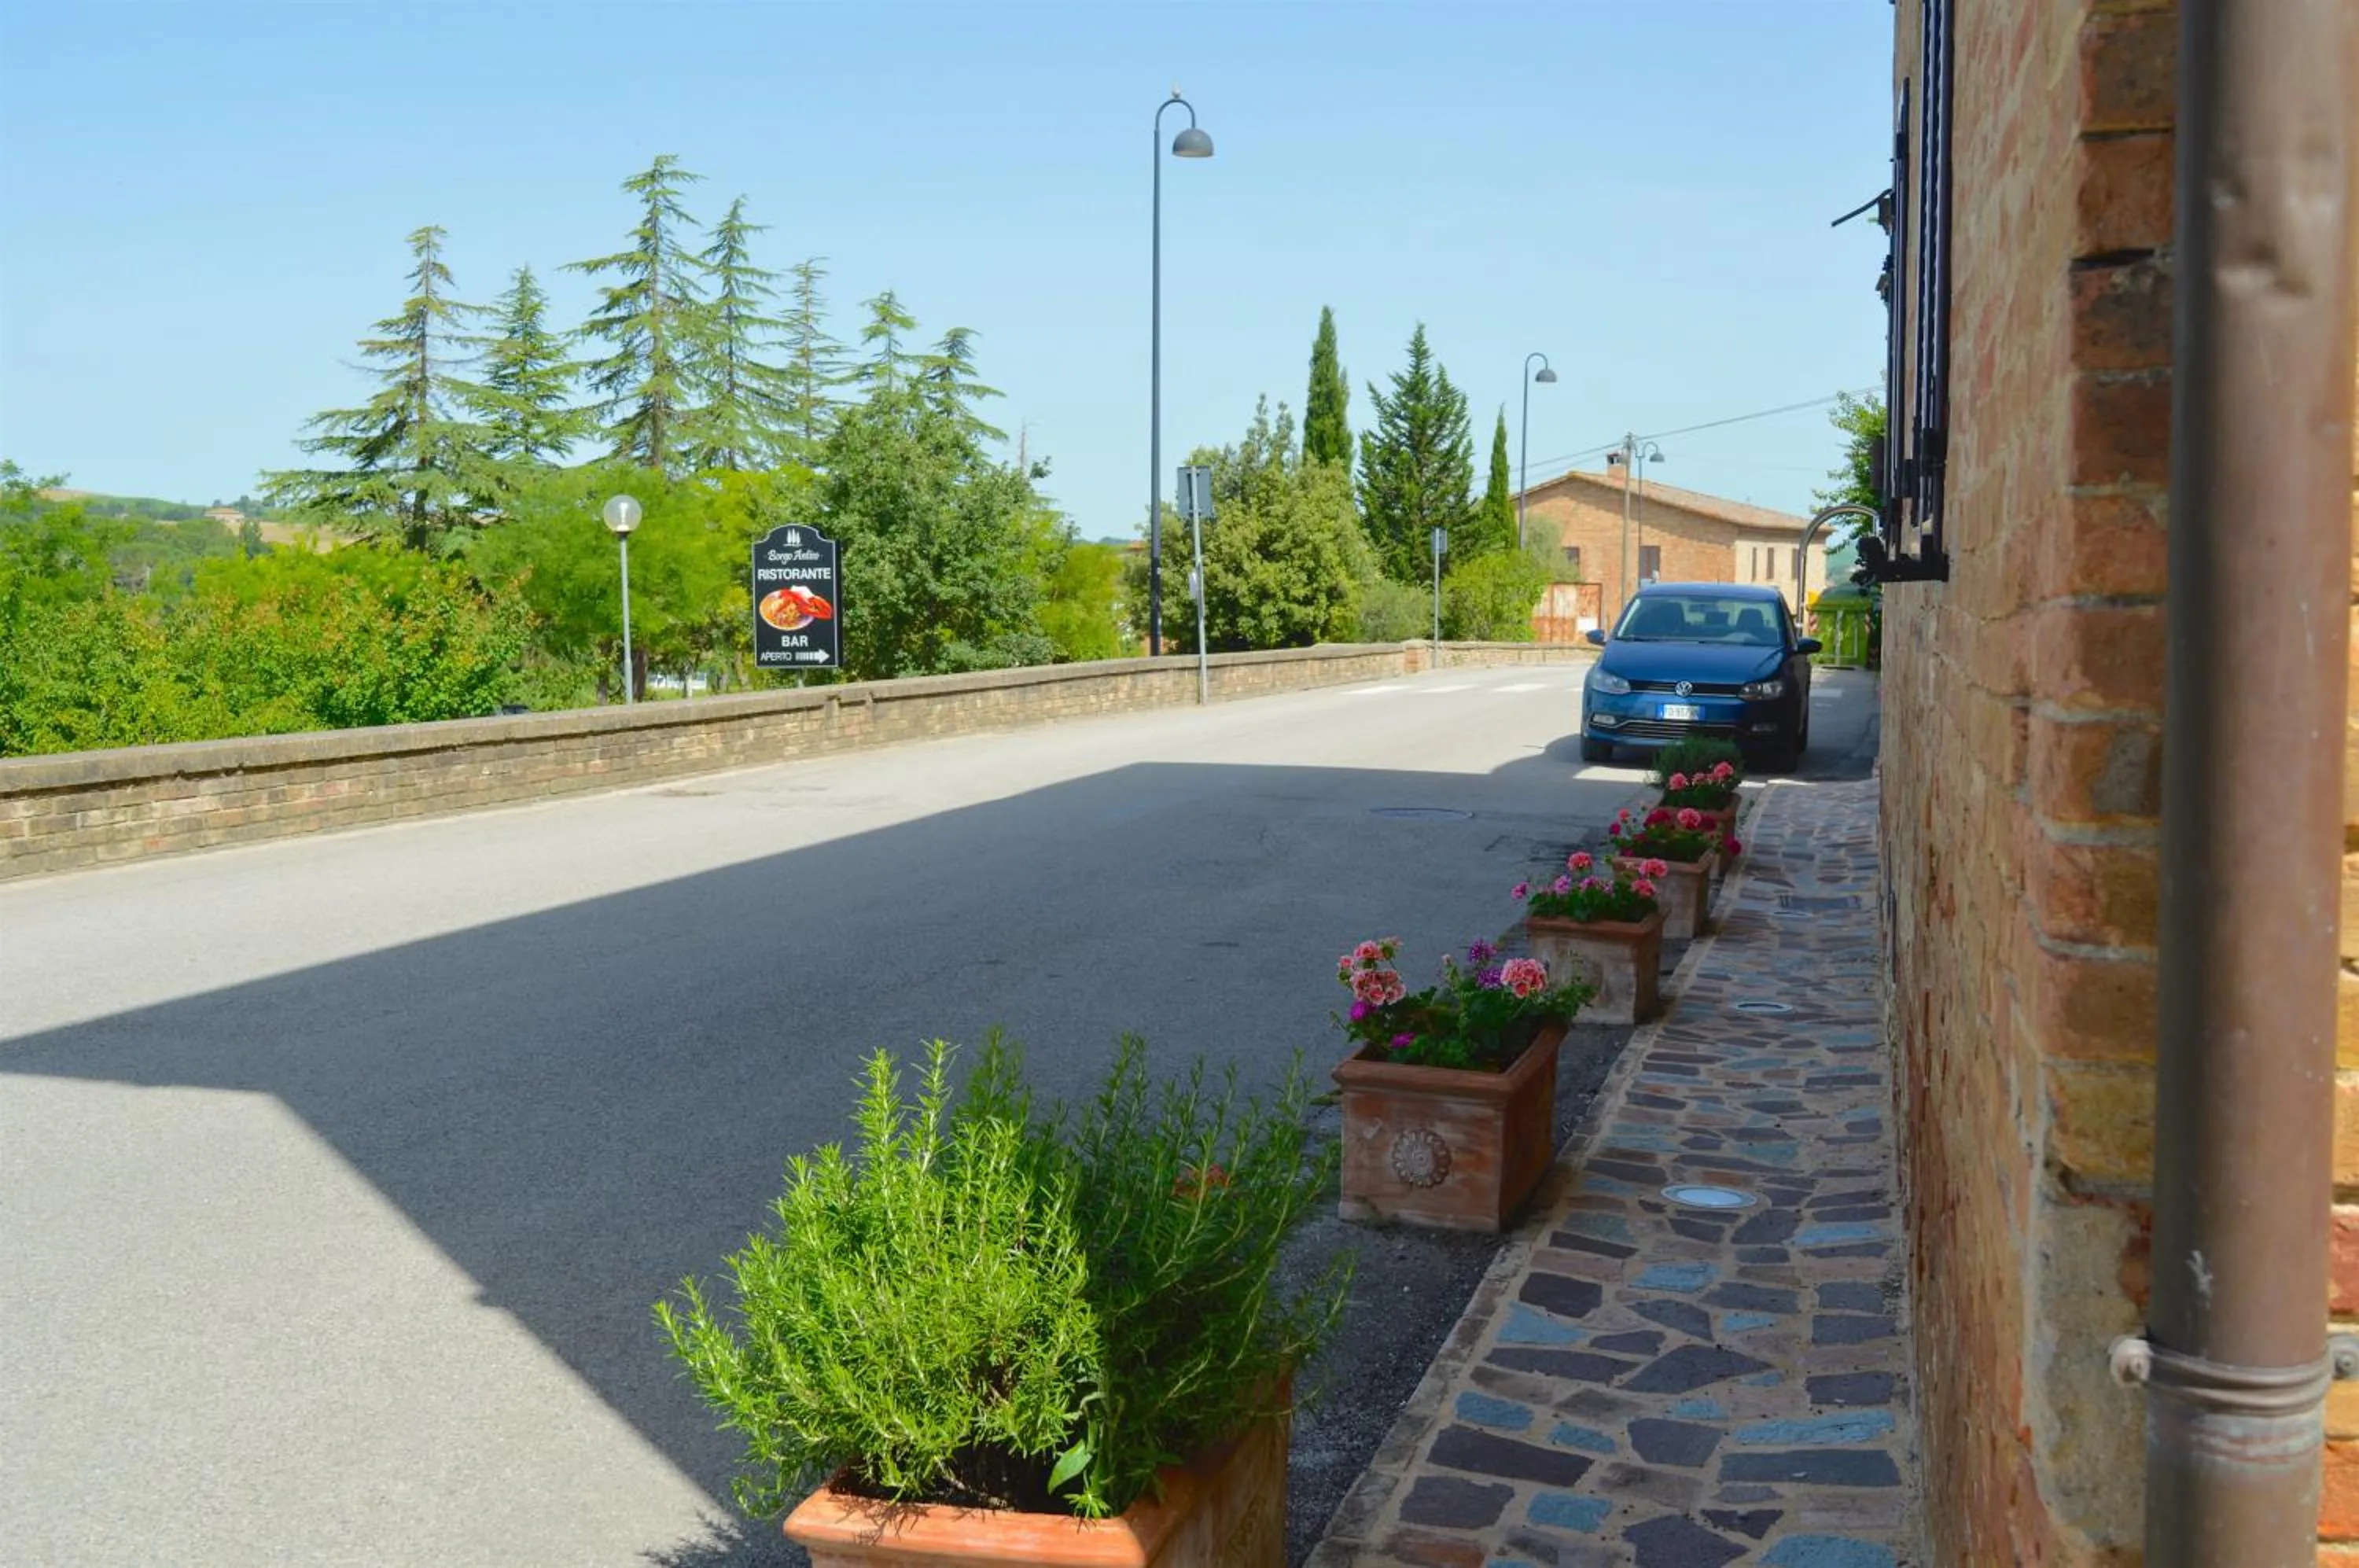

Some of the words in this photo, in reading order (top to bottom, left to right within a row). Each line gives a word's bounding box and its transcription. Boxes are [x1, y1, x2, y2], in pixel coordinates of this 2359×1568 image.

[767, 550, 793, 565] Borgo
[757, 568, 831, 580] RISTORANTE
[781, 635, 808, 647] BAR
[760, 652, 792, 661] APERTO
